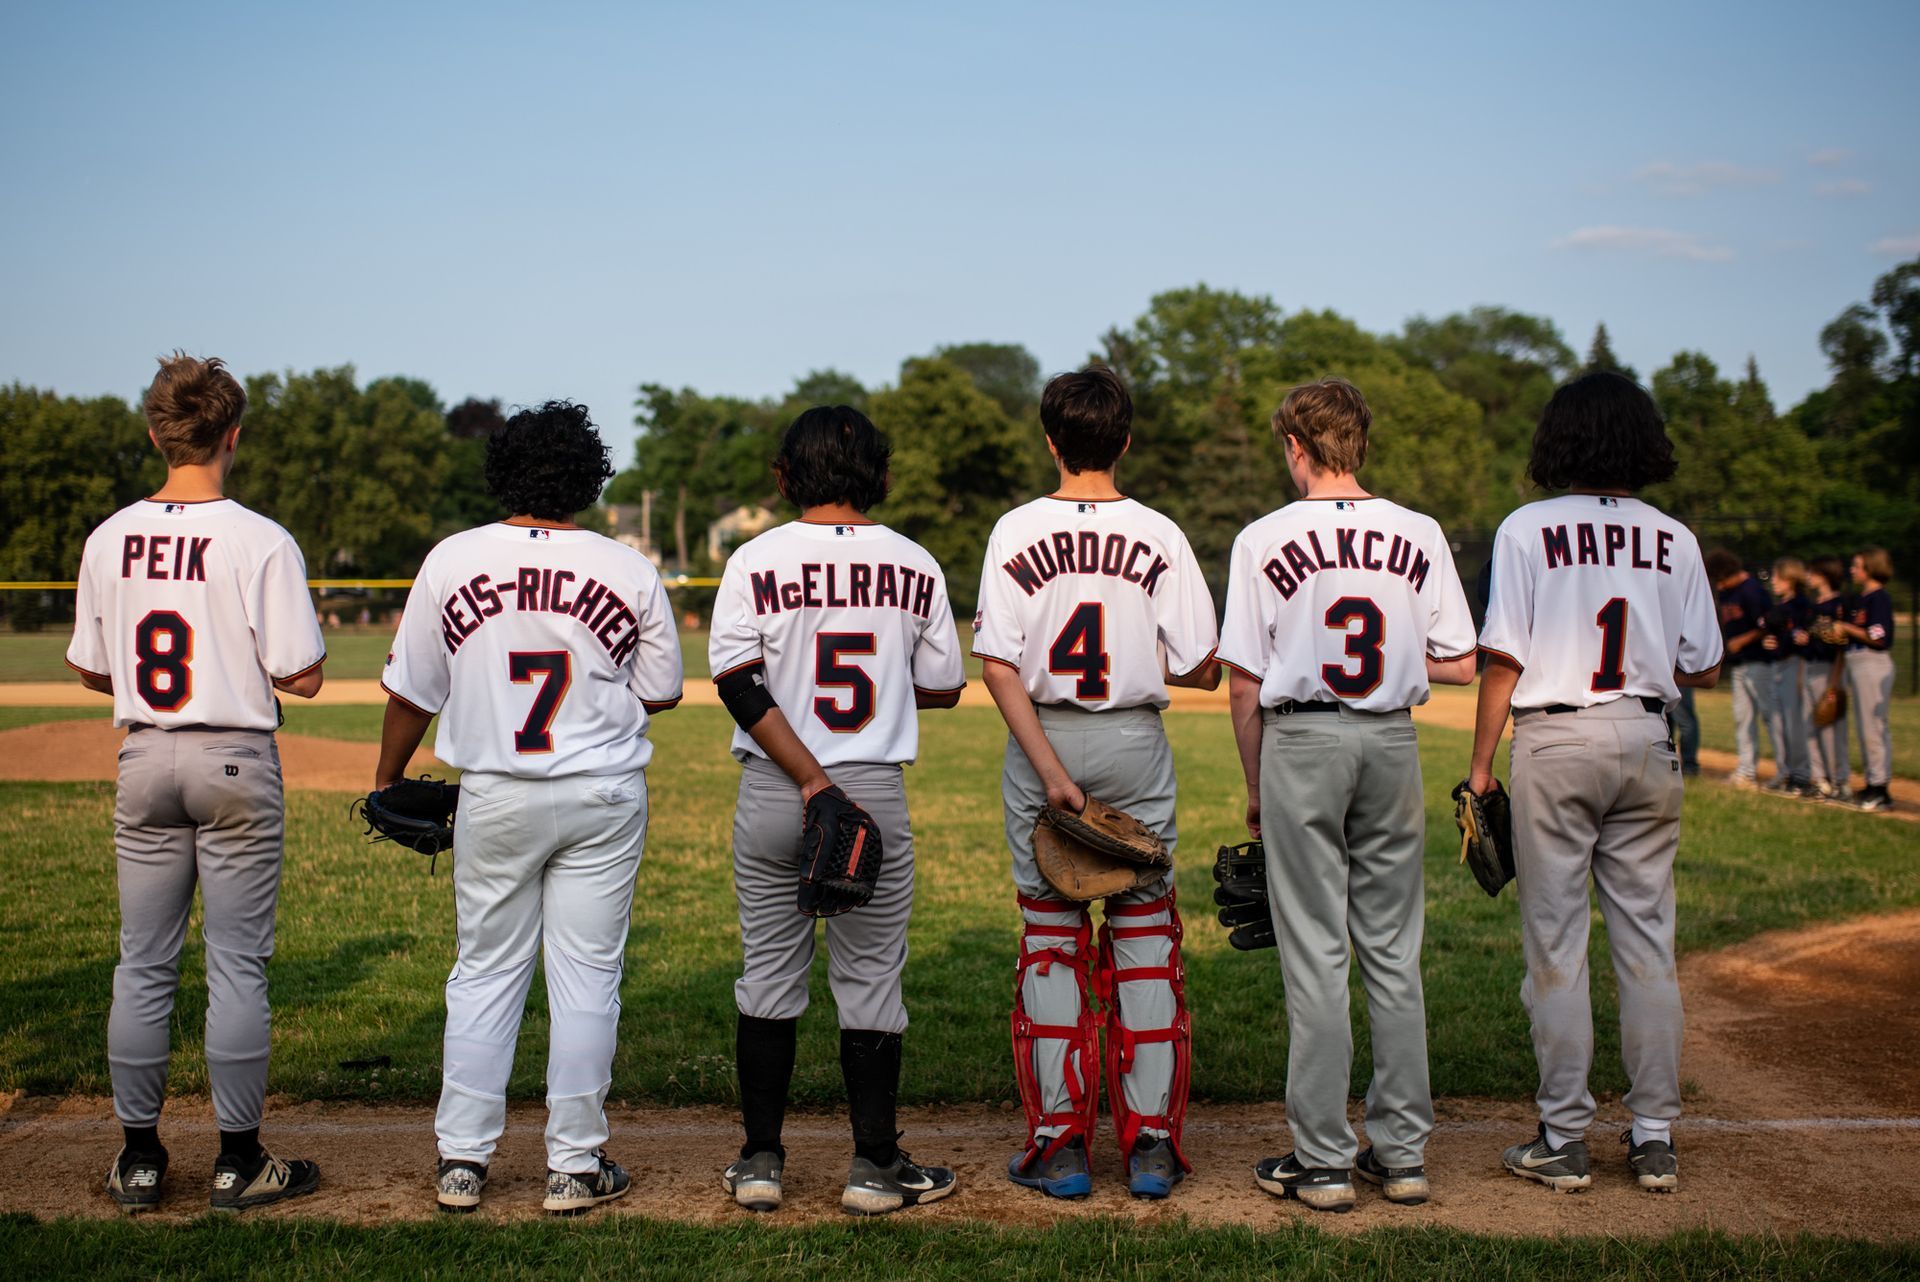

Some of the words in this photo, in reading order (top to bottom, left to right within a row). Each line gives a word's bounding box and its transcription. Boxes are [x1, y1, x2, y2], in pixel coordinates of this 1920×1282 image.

[122, 535, 212, 582] PEIK
[750, 563, 935, 619] McELRATH
[1002, 531, 1169, 597] WURDOCK
[1263, 528, 1431, 601] BALKCUM
[1542, 523, 1674, 574] MAPLE
[135, 610, 194, 713] 8
[442, 567, 641, 669] REIS-RICHTER
[1048, 601, 1111, 701] 4
[1321, 596, 1386, 699] 3
[1590, 597, 1629, 692] 1
[509, 650, 572, 755] 7
[814, 632, 877, 733] 5
